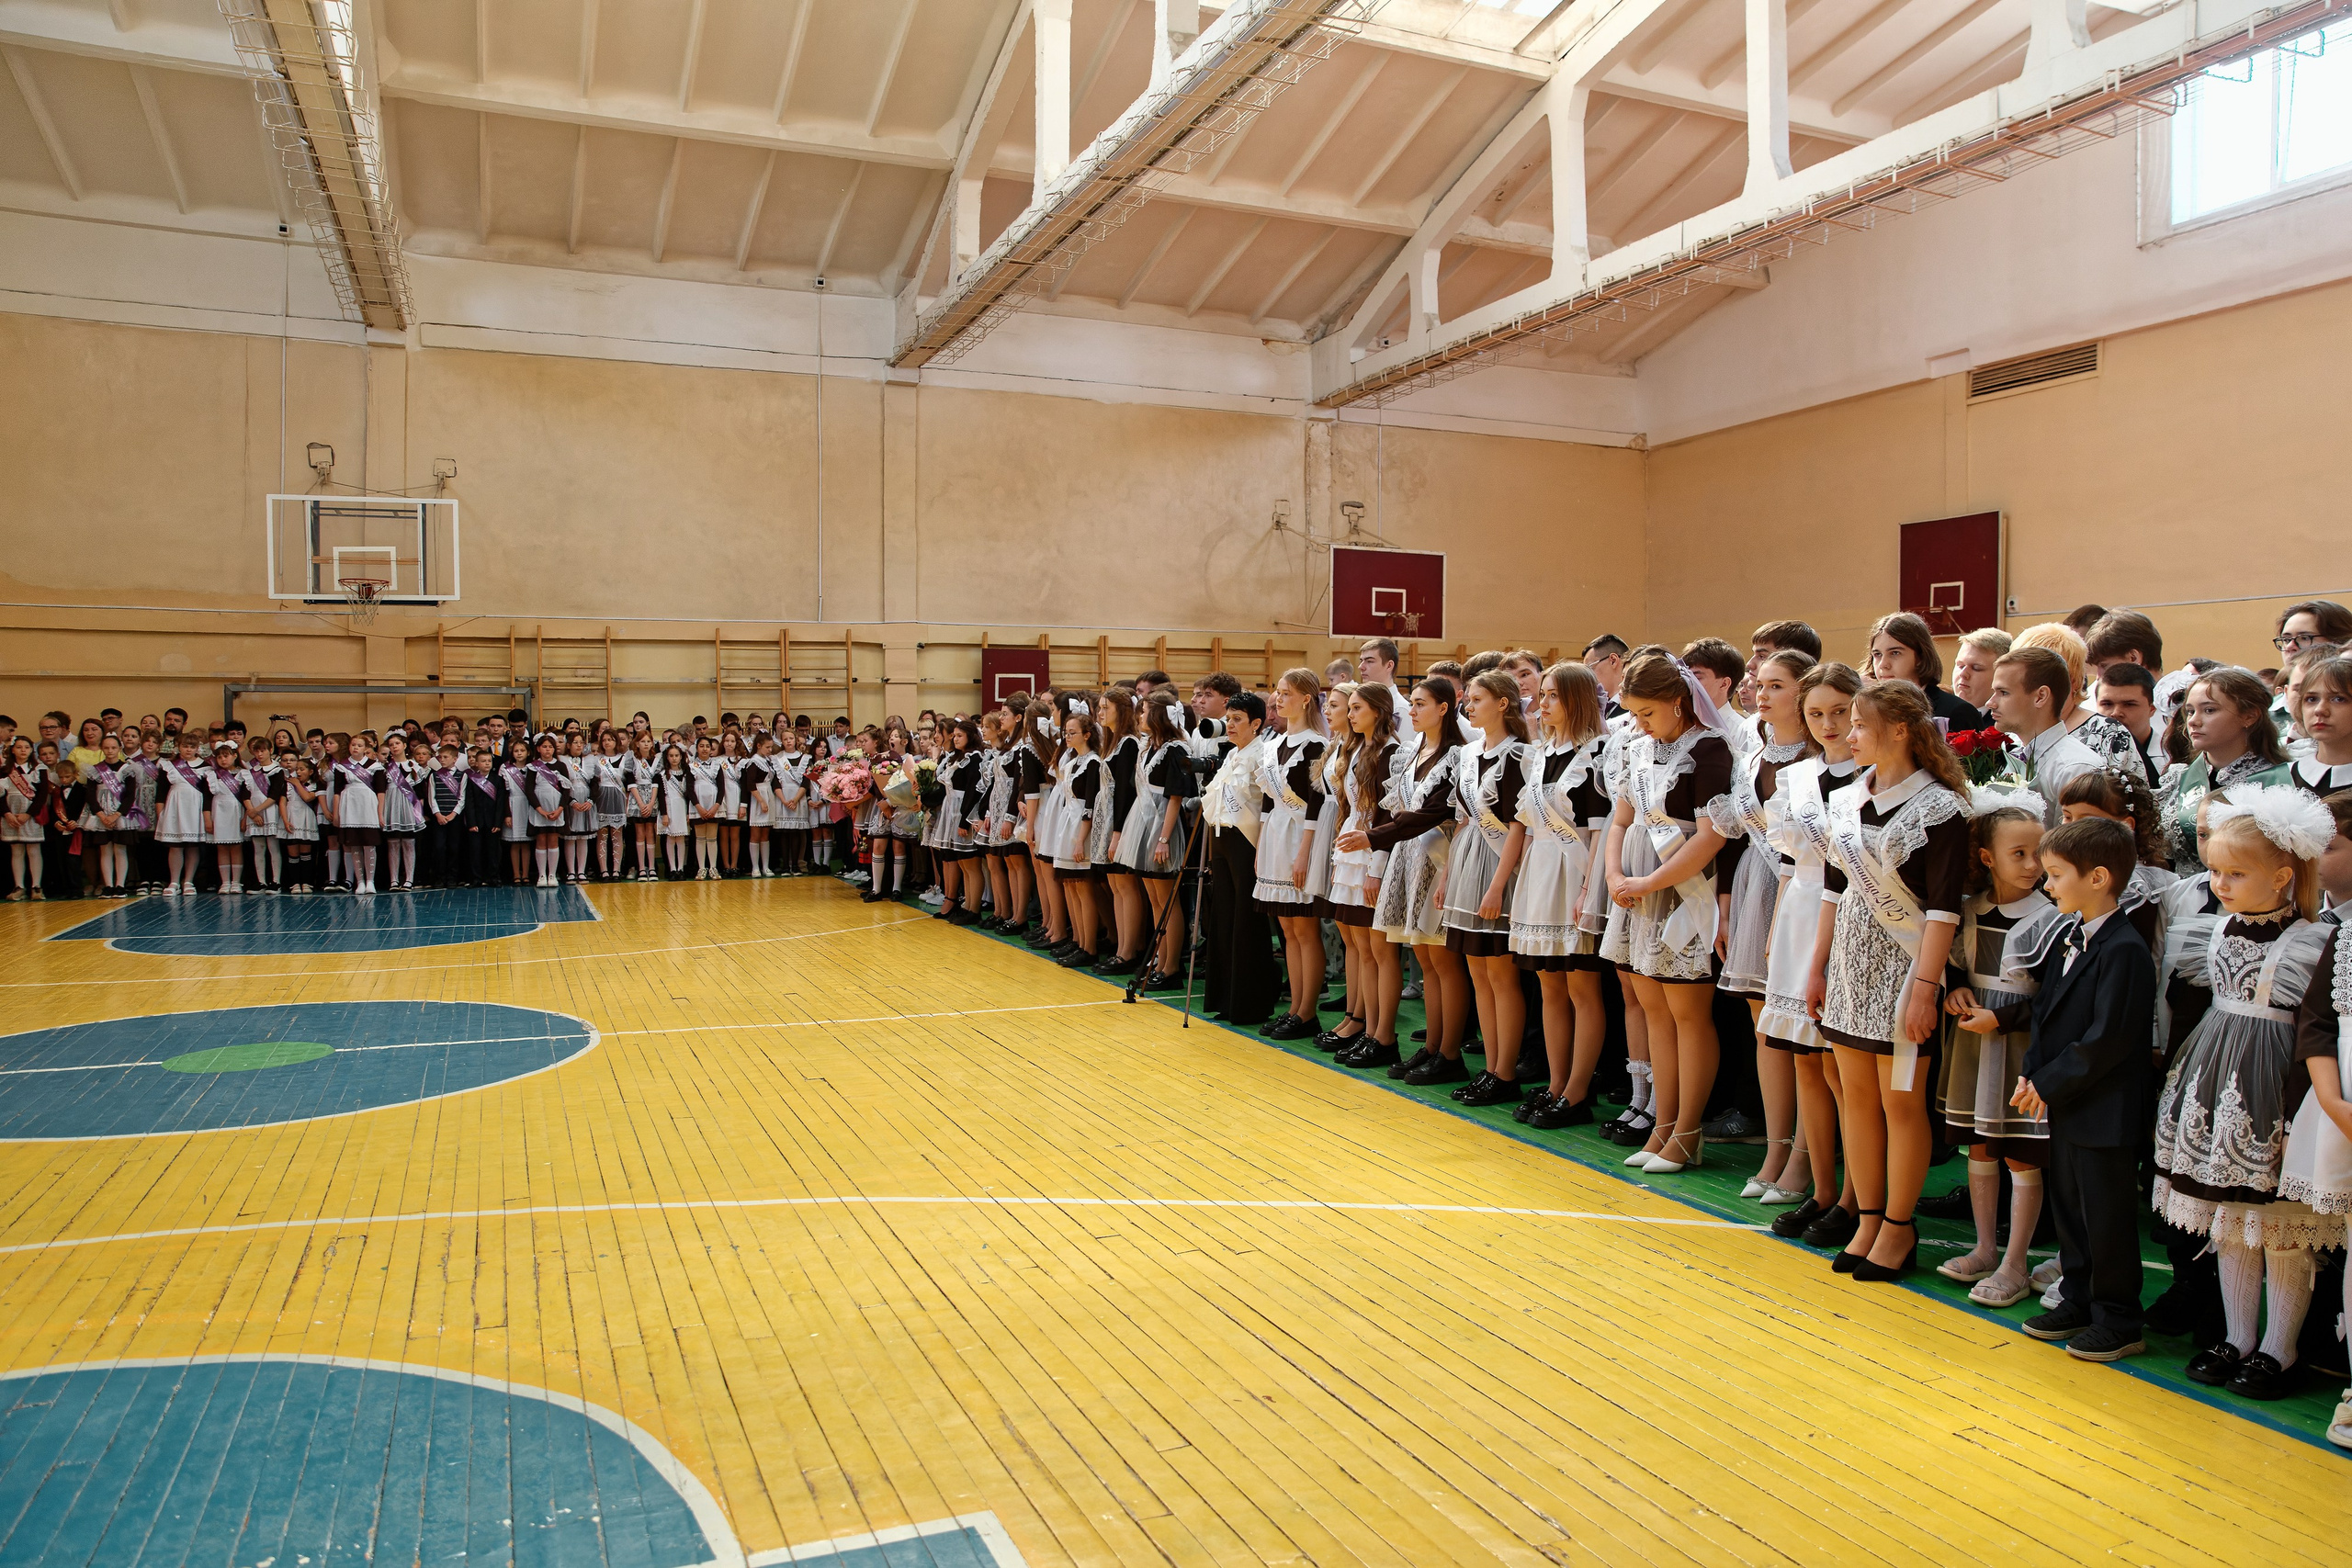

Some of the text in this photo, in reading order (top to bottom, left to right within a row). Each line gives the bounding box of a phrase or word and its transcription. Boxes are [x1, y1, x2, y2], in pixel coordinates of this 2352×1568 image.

[1227, 795, 1242, 813] 2025
[1283, 796, 1302, 811] 2025
[1480, 820, 1504, 840] 2025
[1552, 824, 1577, 844] 2025
[1651, 815, 1673, 837] 2025
[1800, 801, 1827, 852] Выпуск
[1839, 820, 1880, 896] Выпускница
[1874, 893, 1911, 921] 2025
